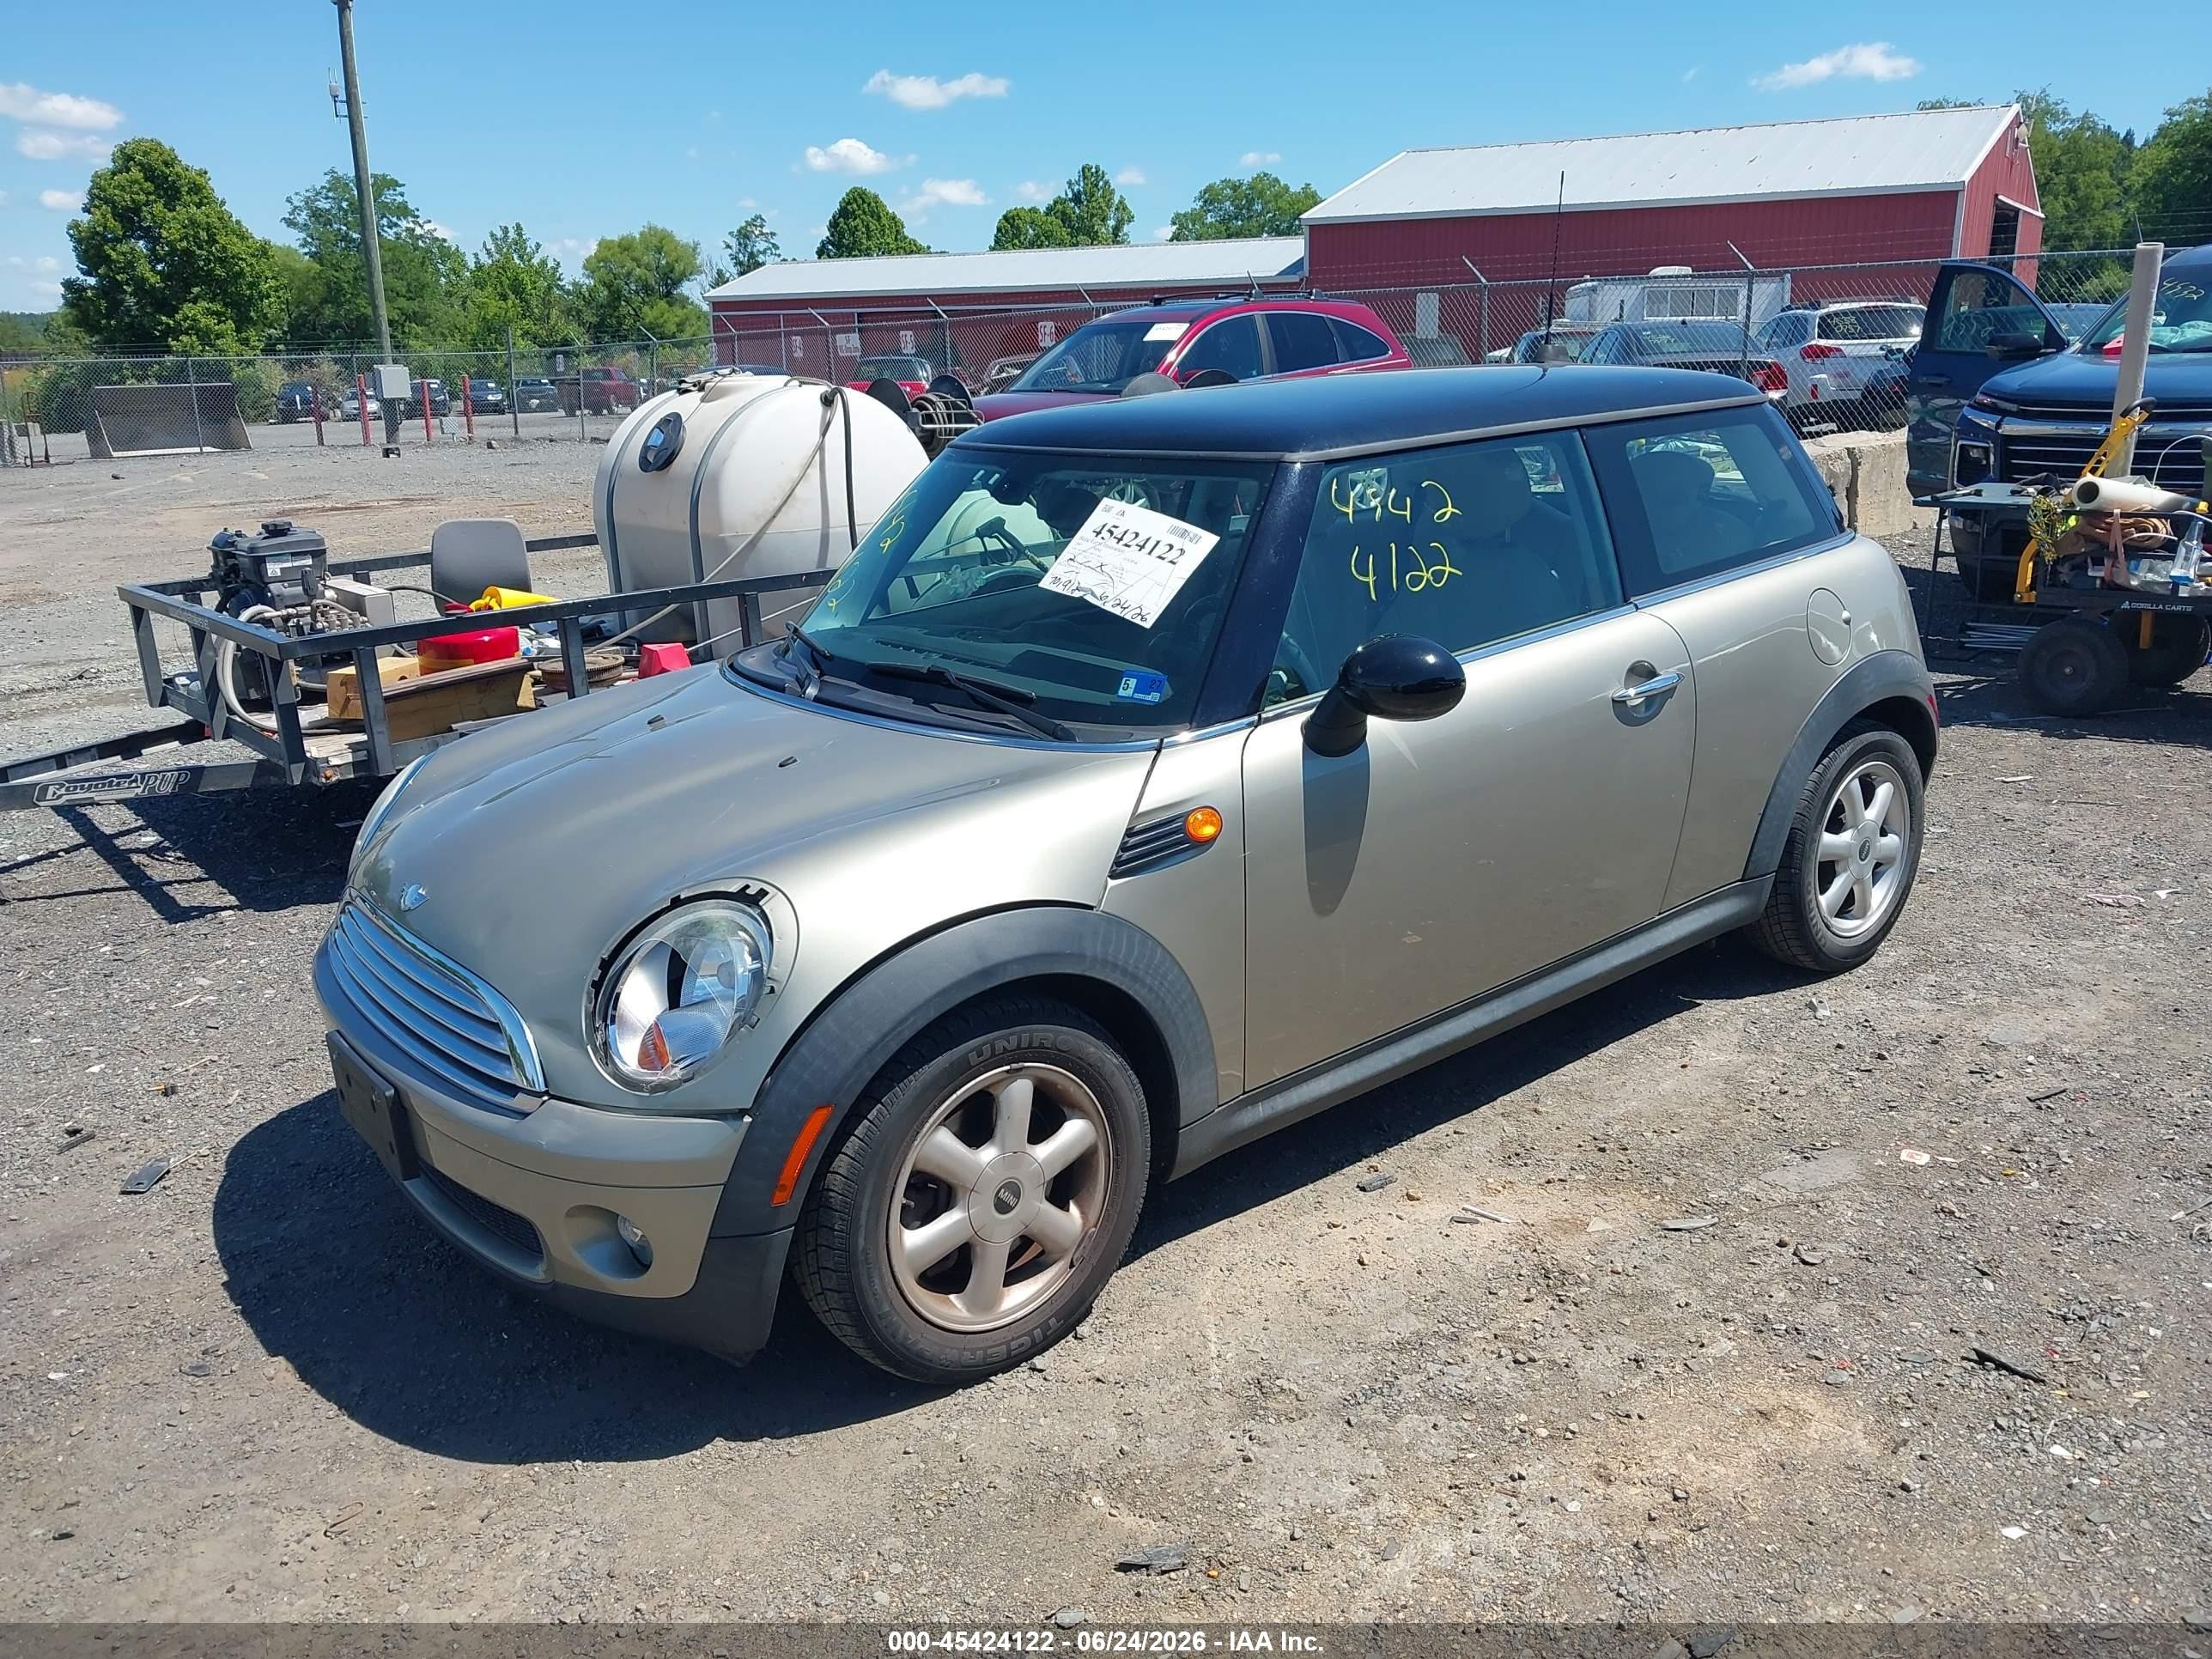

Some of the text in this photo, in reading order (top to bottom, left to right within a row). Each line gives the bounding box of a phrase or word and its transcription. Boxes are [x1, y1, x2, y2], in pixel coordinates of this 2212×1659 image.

[1092, 522, 1186, 565] 45424122
[1351, 542, 1463, 601] 4122
[2130, 602, 2164, 611] GORILLA
[1121, 679, 1131, 691] 5
[138, 771, 191, 797] PUP
[998, 1188, 1018, 1208] MINI
